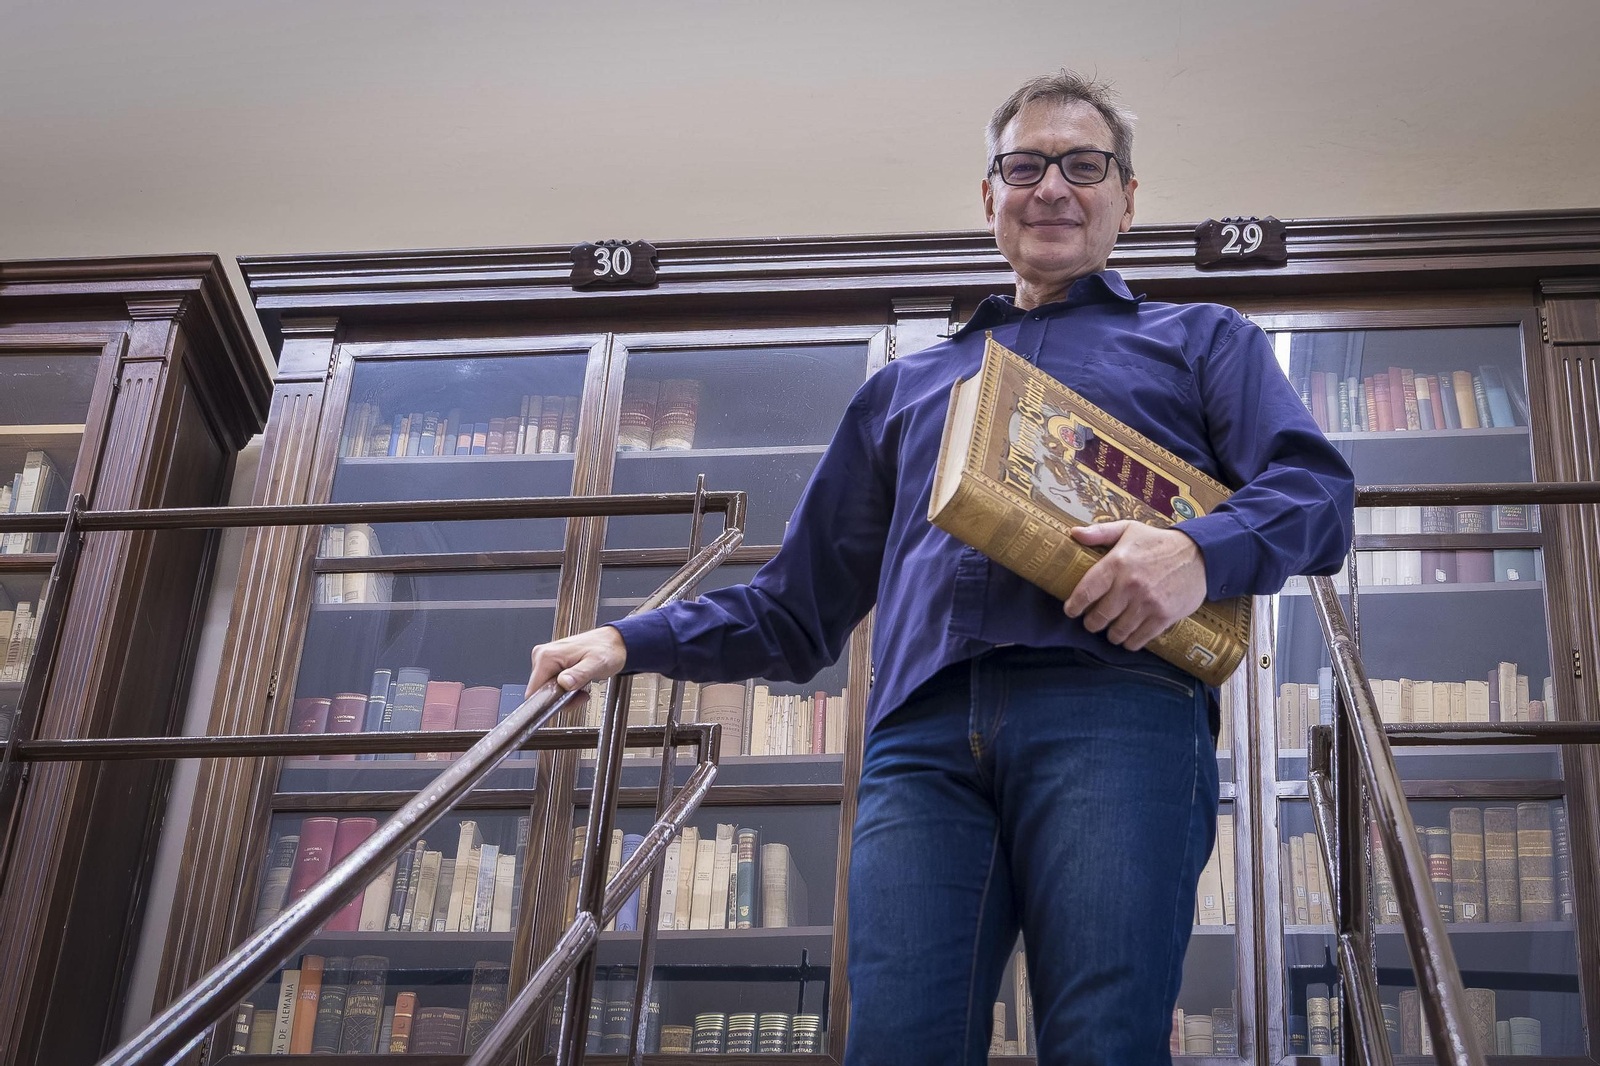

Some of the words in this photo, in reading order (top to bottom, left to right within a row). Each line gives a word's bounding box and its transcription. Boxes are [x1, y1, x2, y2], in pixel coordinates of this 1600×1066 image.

[1221, 223, 1263, 254] 29
[593, 246, 632, 276] 30
[281, 983, 296, 1025] ALEMANIA
[278, 1028, 288, 1040] DE
